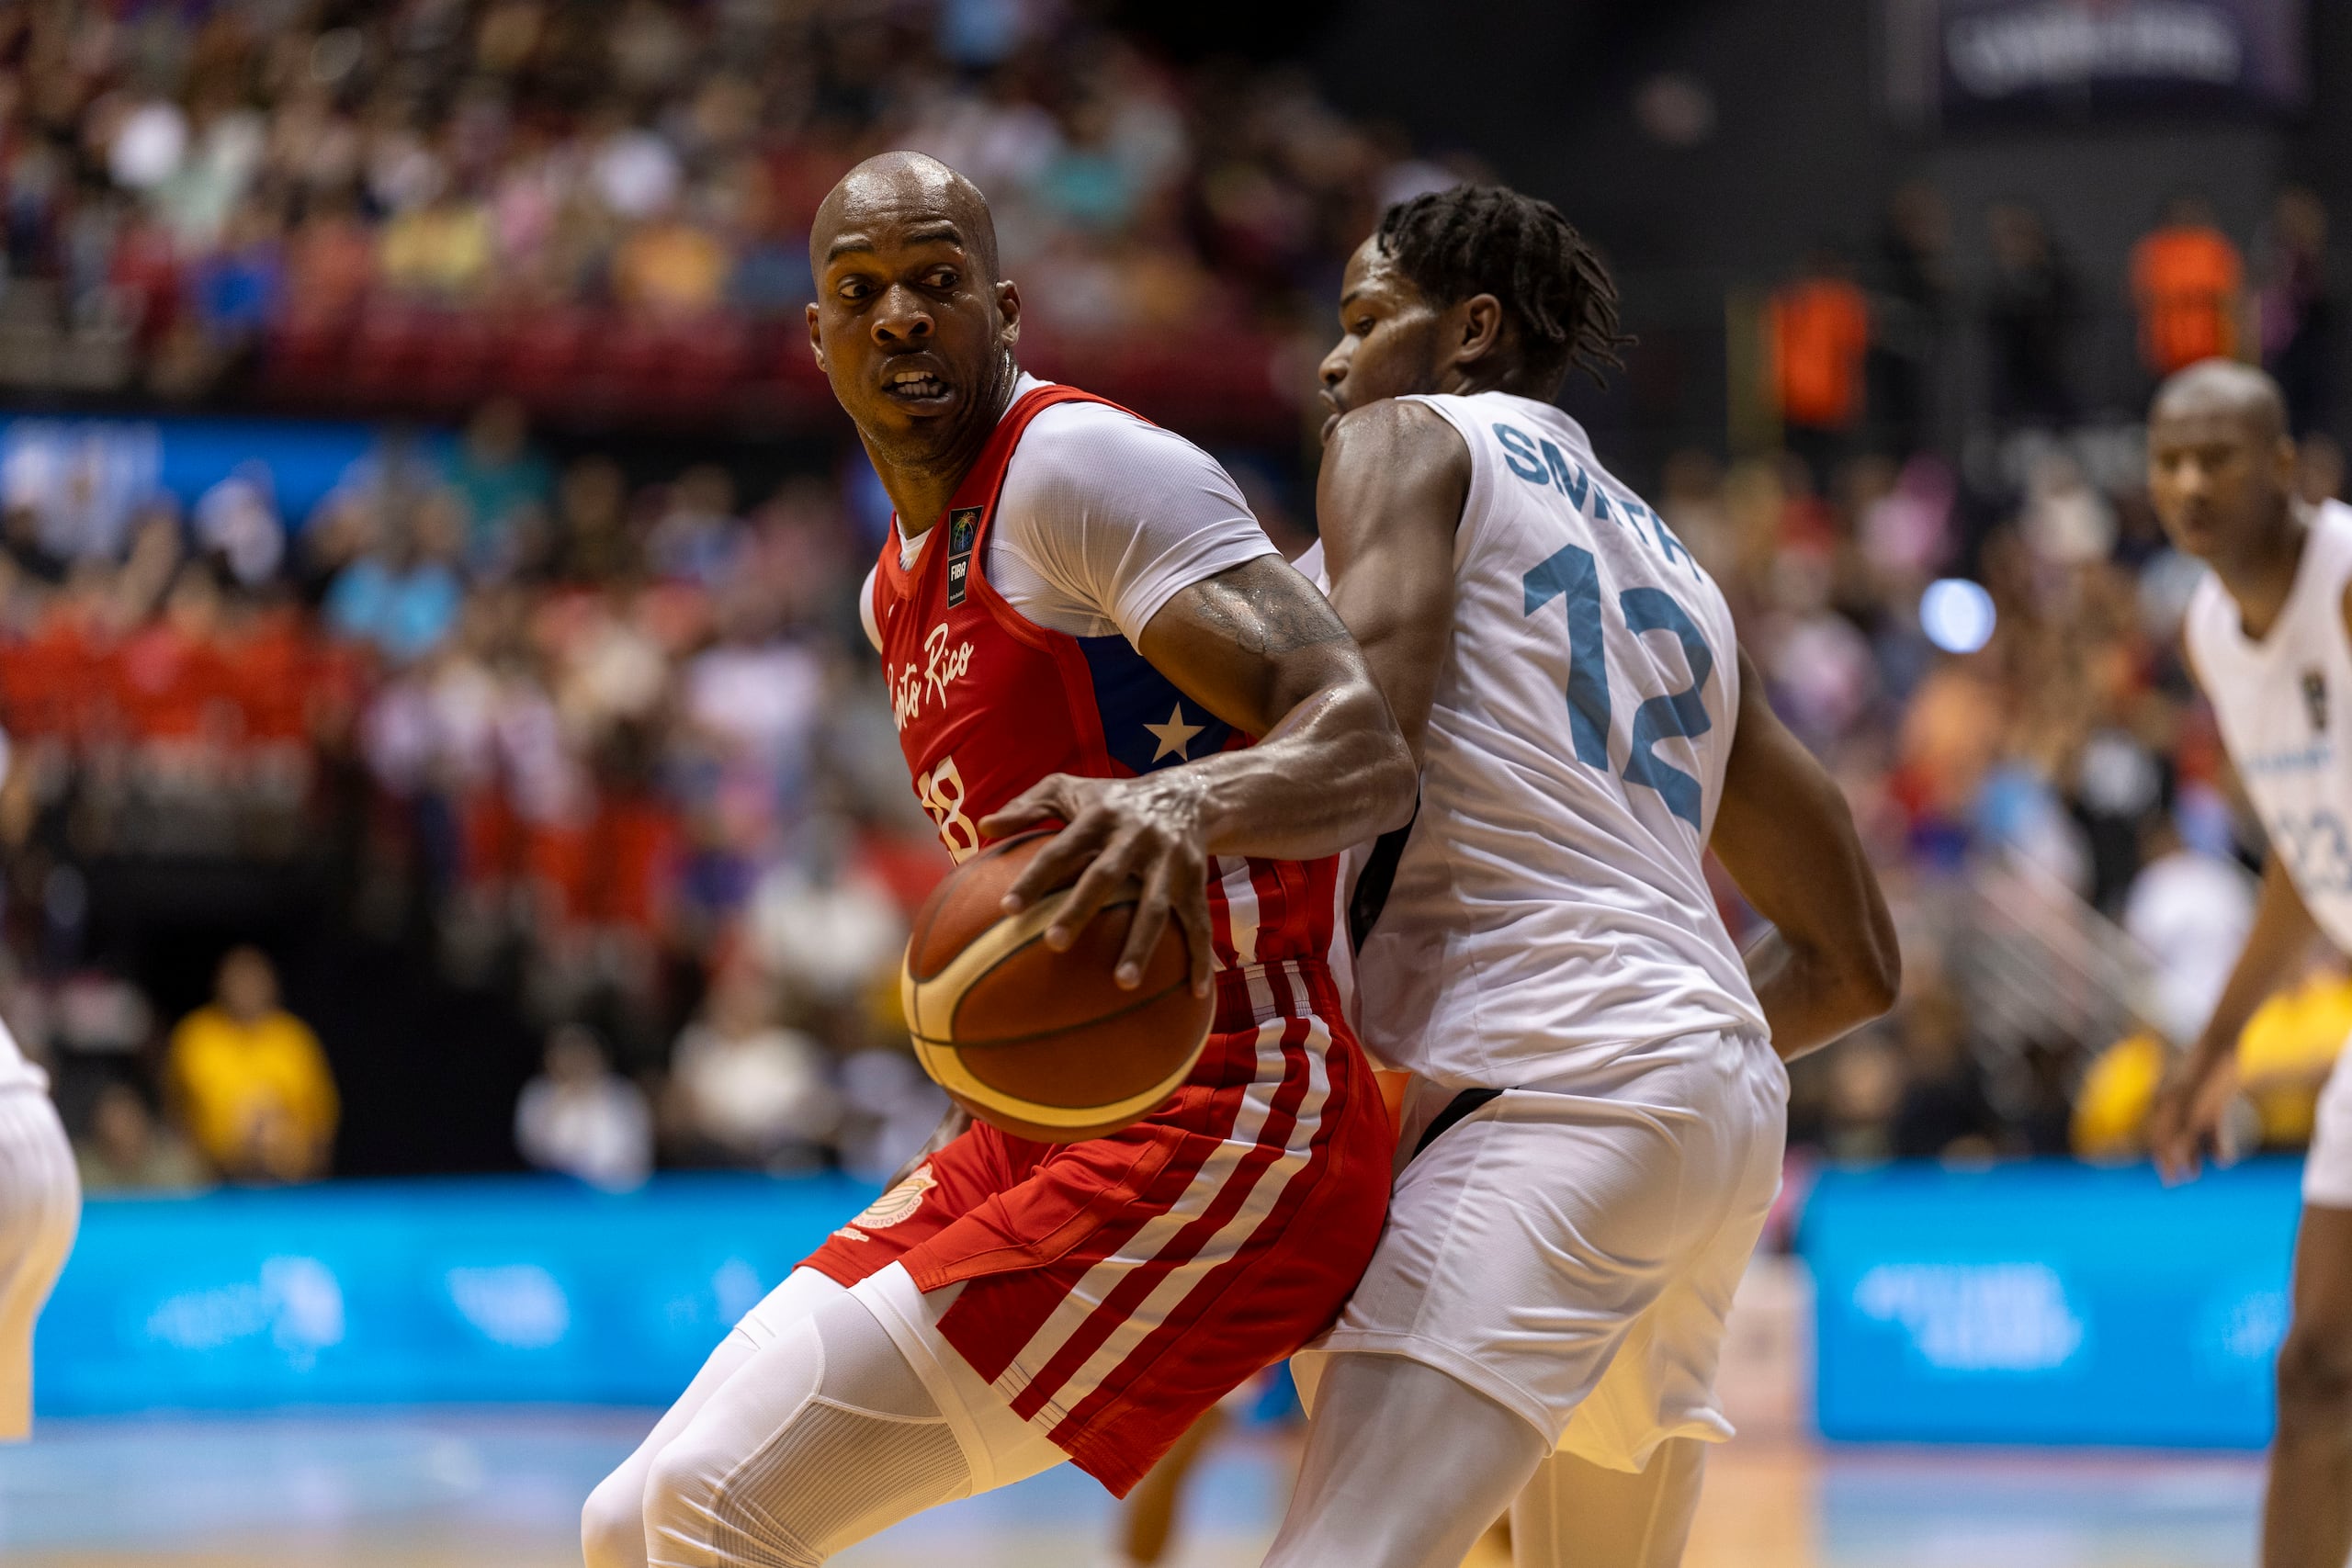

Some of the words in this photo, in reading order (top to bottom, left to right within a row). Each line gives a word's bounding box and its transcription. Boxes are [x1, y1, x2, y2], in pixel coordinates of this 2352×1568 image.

[1492, 423, 1702, 584] SMITH
[950, 561, 967, 581] FIBA
[888, 662, 922, 732] erto
[924, 623, 974, 709] Rico
[1523, 543, 1713, 834] 12
[896, 1197, 921, 1221] RICO
